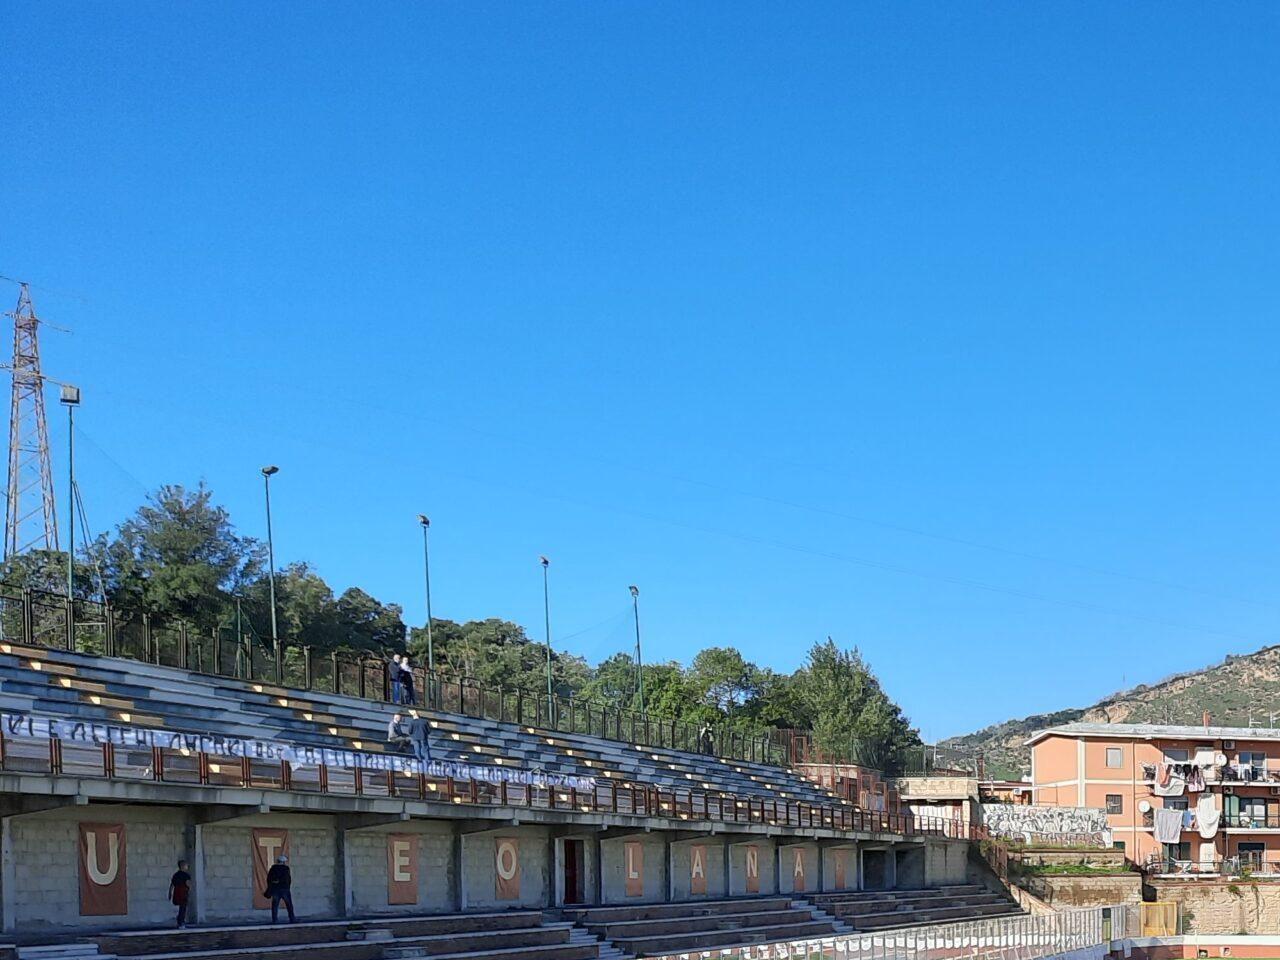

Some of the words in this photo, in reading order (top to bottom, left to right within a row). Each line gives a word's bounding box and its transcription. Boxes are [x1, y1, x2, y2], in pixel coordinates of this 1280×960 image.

[86, 831, 119, 886] U
[393, 841, 412, 882] E
[496, 842, 517, 880] O
[628, 847, 639, 879] L
[691, 850, 704, 879] A
[746, 851, 758, 878] N
[794, 852, 804, 877] A
